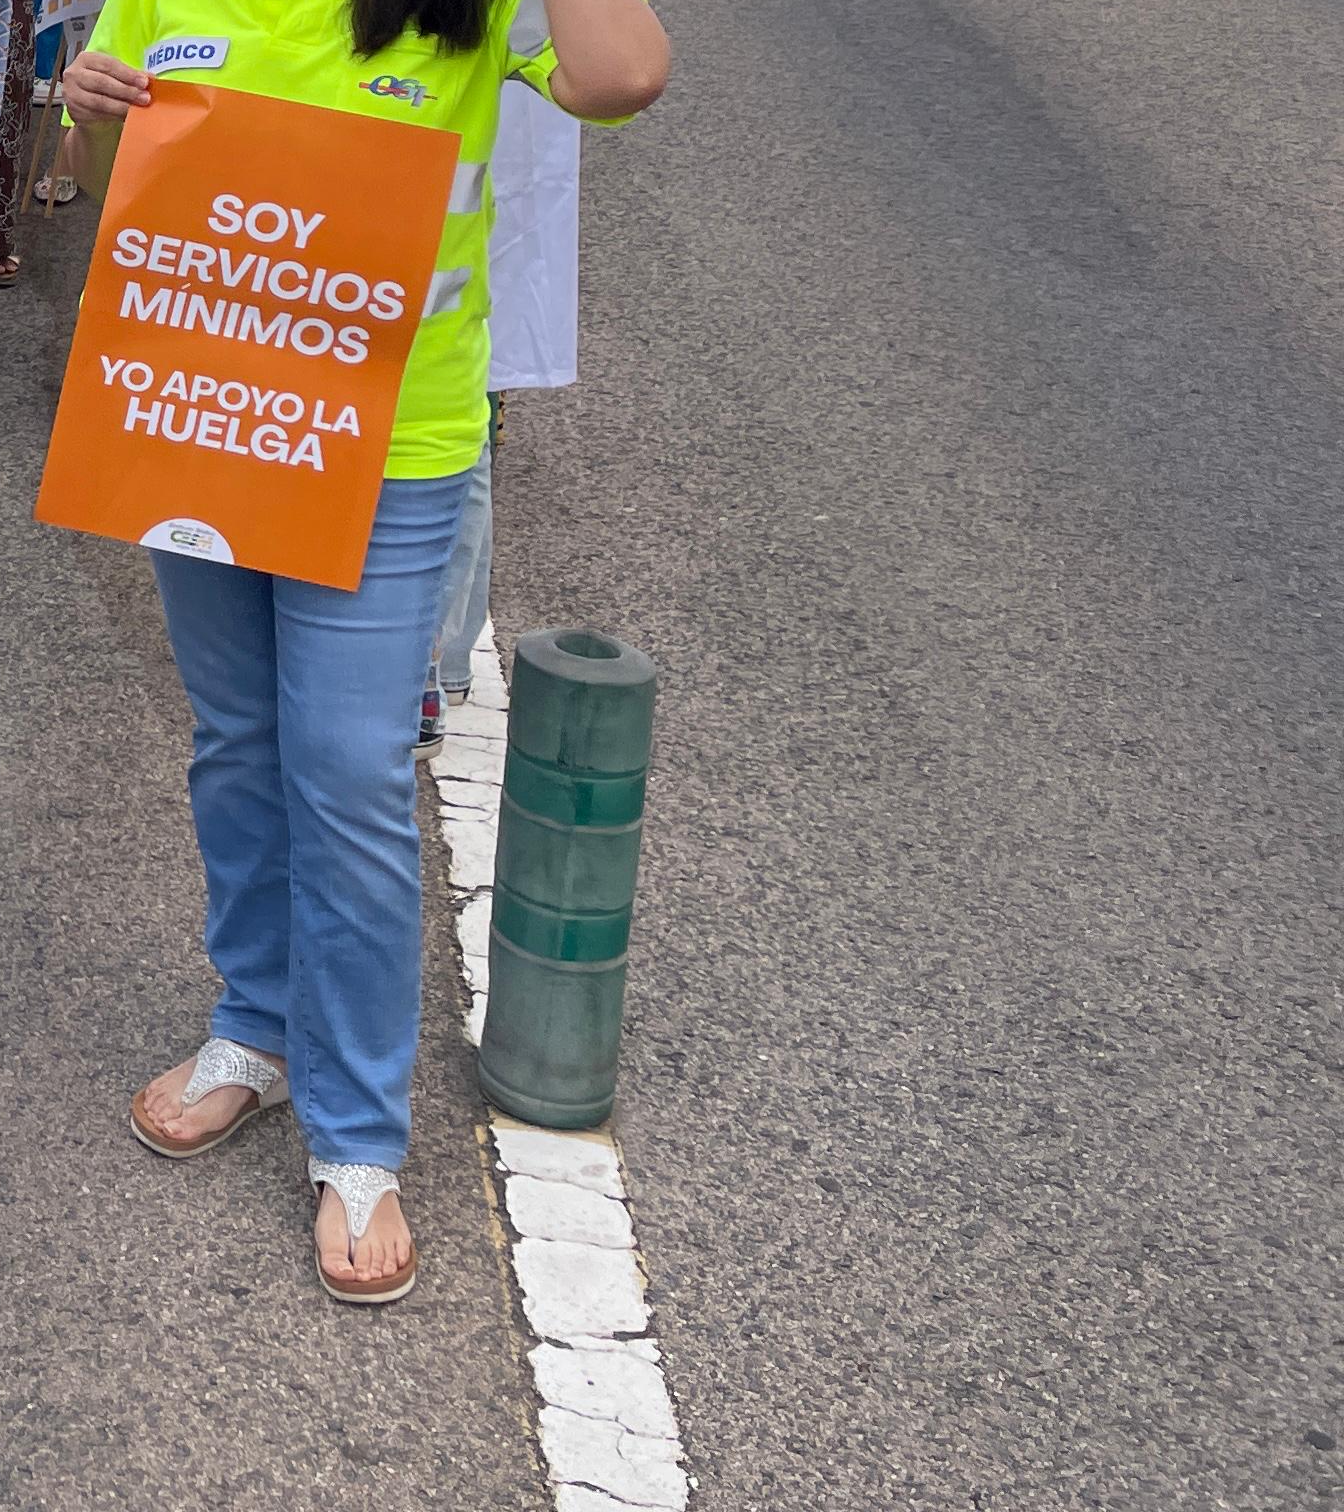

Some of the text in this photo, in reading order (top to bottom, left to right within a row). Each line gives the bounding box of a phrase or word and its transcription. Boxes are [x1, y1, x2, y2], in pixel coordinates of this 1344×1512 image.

[147, 44, 216, 70] MÉDICO
[208, 193, 326, 249] SOY
[112, 228, 406, 321] SERVICIOS
[119, 282, 370, 364] MÍNIMOS
[100, 355, 361, 437] YO APOYO LA
[123, 397, 325, 472] HUELGA
